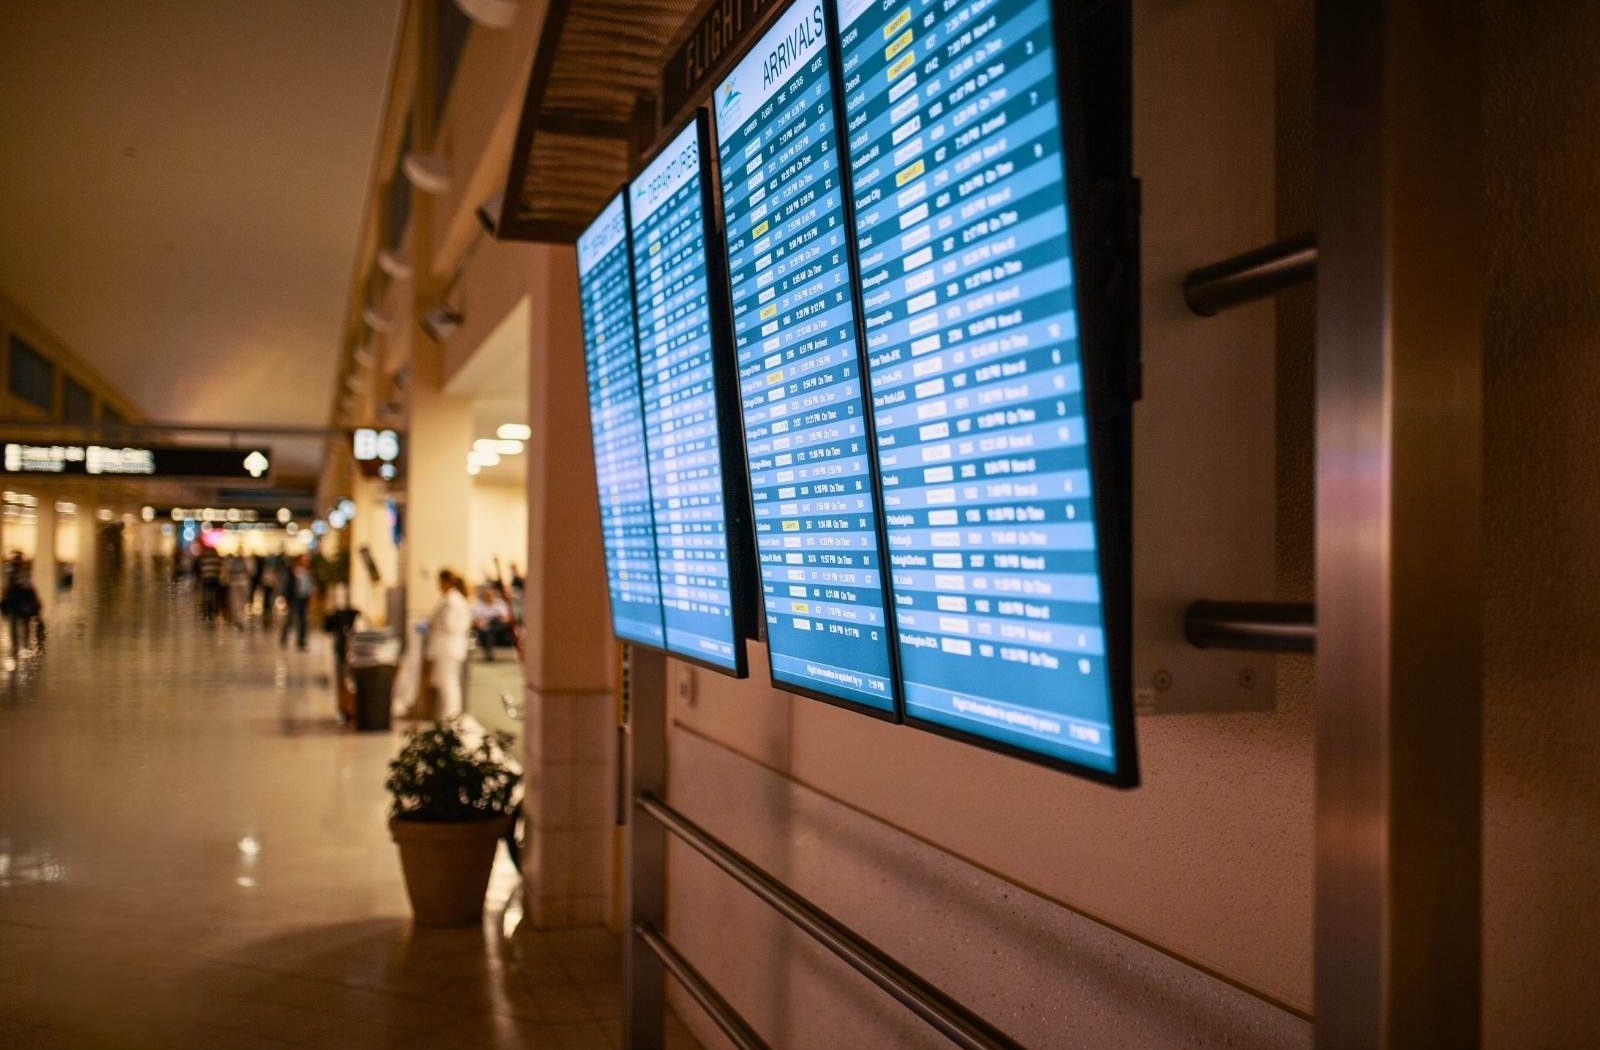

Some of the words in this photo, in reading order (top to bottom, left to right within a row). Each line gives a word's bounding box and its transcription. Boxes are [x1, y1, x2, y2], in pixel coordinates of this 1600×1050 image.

[763, 4, 824, 91] ARRIVALS
[842, 27, 857, 50] ORIGIN
[843, 52, 858, 74] Detroit
[777, 93, 787, 105] TIME
[789, 76, 804, 95] STATUS
[811, 57, 823, 73] GATE
[845, 72, 860, 94] Detroit
[848, 110, 866, 132] Hartford
[855, 193, 870, 211] Kansas
[870, 186, 881, 203] City
